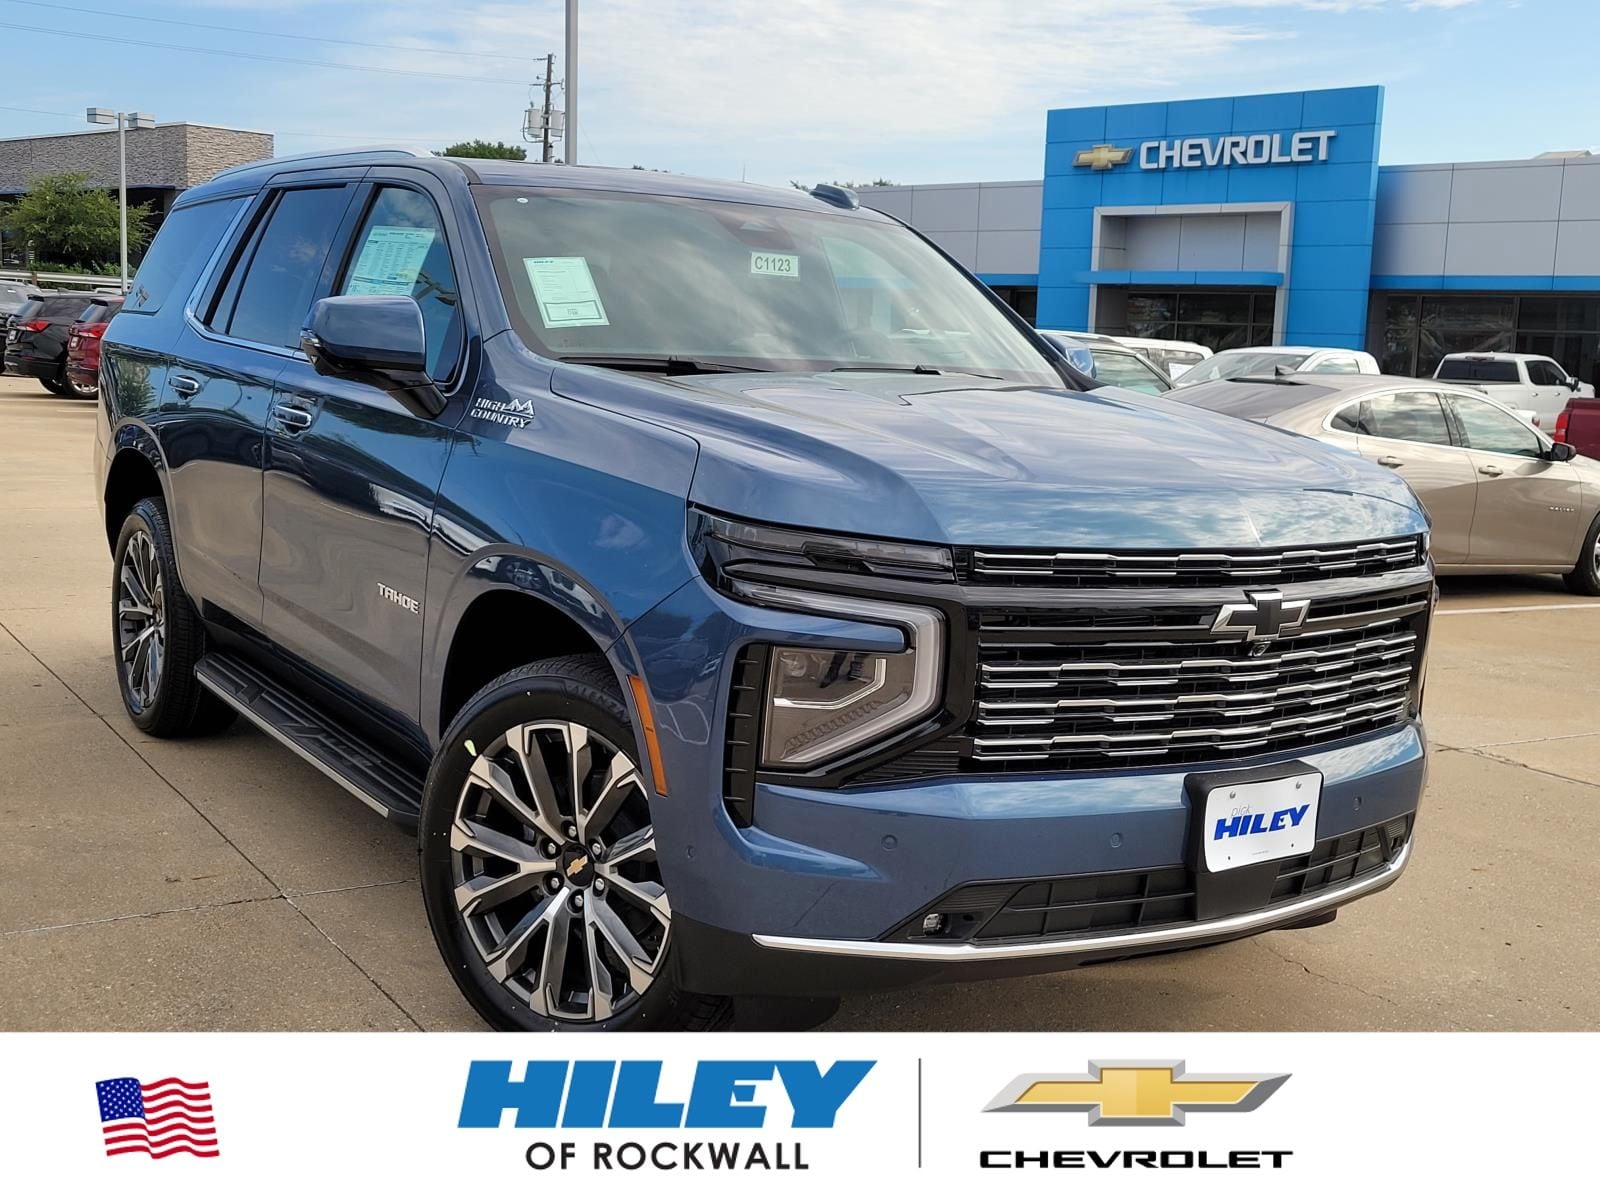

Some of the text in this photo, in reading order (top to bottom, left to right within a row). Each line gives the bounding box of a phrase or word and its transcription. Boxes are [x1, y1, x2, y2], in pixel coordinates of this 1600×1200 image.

[1139, 129, 1336, 170] CHEVROLET
[754, 255, 791, 272] C1123
[470, 408, 531, 428] COUNTRY
[475, 398, 507, 412] HIGH
[377, 582, 419, 614] TAHOE
[1214, 804, 1310, 840] HILEY
